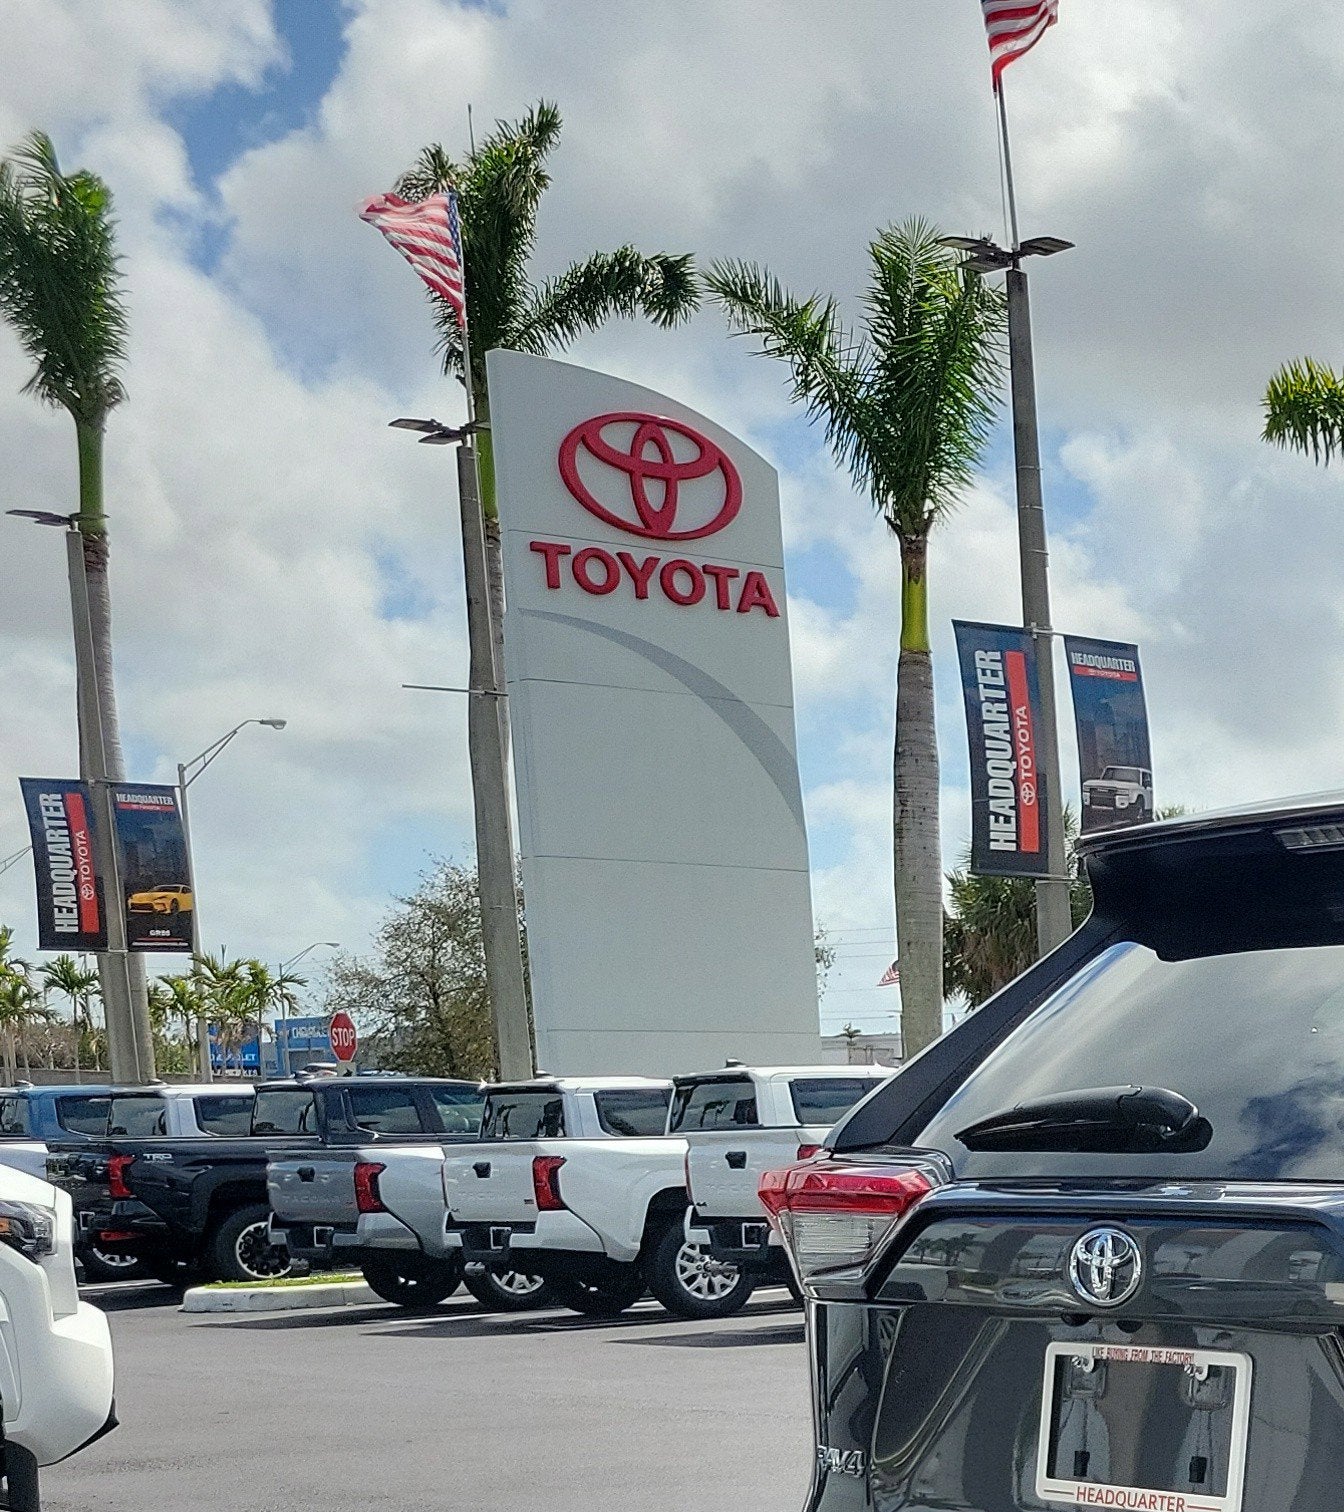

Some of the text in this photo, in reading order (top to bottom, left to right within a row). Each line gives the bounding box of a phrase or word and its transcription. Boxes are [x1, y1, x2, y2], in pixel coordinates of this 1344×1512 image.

[529, 541, 780, 617] TOYOTA
[1070, 651, 1136, 672] HEADQUARTER
[974, 650, 1018, 852] HEADQUARTER
[1015, 705, 1034, 780] TOYOTA
[116, 793, 174, 806] HEADQUARTER
[39, 793, 79, 933] HEADQUARTER
[75, 830, 92, 883] TOYOTA
[332, 1027, 355, 1047] STOP
[142, 1153, 174, 1161] TRD
[1093, 1347, 1105, 1360] LIKE
[1131, 1349, 1148, 1362] FROM
[1151, 1350, 1163, 1363] THE
